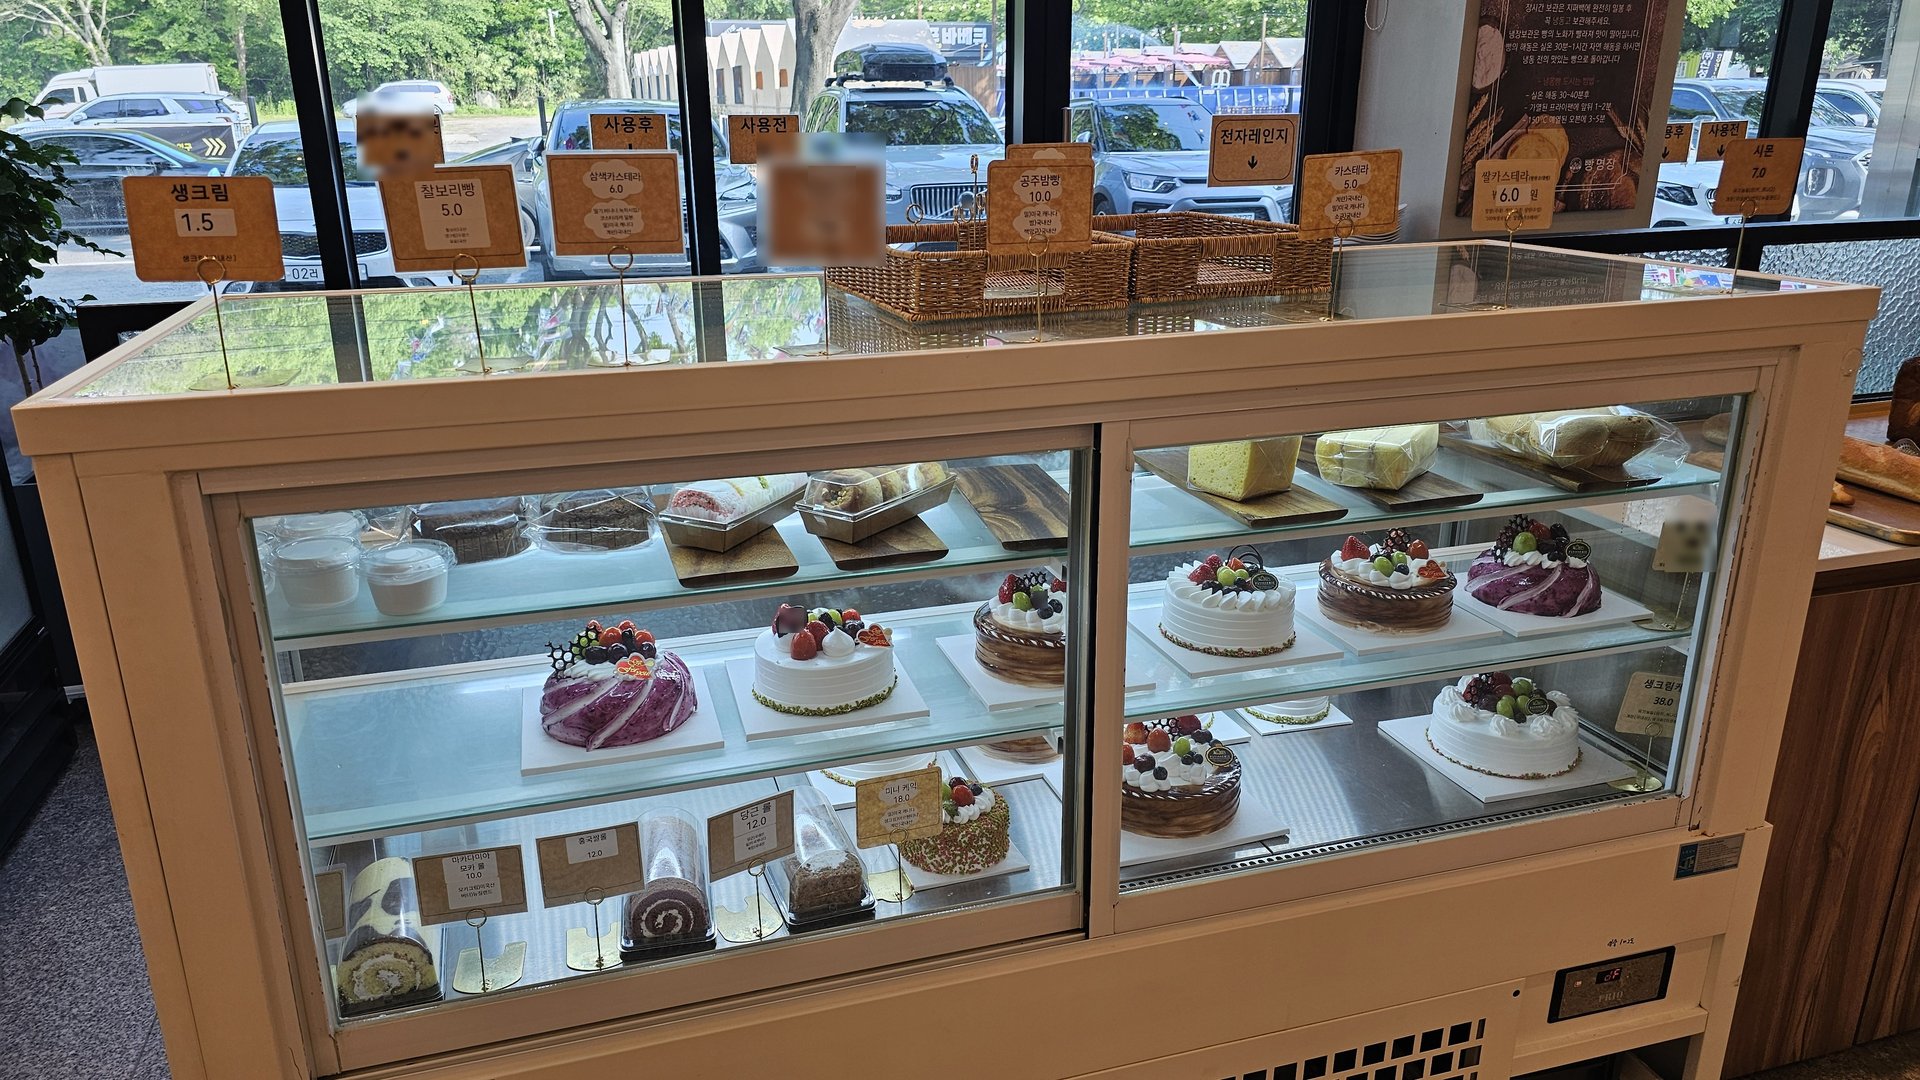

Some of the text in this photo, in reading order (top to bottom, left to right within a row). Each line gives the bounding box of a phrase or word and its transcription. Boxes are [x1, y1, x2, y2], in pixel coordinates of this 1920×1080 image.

[1526, 3, 1544, 13] 장시간
[1546, 3, 1565, 13] 보관은
[1508, 29, 1540, 40] 냉장보관은
[1541, 29, 1554, 40] 빵의
[1522, 55, 1535, 65] 냉동
[1570, 54, 1590, 64] 빵으로
[1531, 90, 1544, 100] 실온
[604, 116, 654, 134] 사용후
[740, 116, 788, 134] 사용전
[1708, 124, 1740, 138] 사용전
[1220, 128, 1288, 145] 전자레인지
[1664, 126, 1684, 140] 용후
[1334, 164, 1369, 177] 카스테라
[1584, 158, 1616, 171] 빵명장
[590, 172, 641, 182] 삼색카스테라
[1482, 170, 1530, 184] 쌀카스테라
[1752, 168, 1766, 178] 7.0
[1020, 174, 1060, 188] 공주밤빵
[1344, 180, 1358, 190] 5.0
[170, 184, 229, 202] 생크림
[420, 183, 476, 198] 찰보리빵
[609, 184, 624, 194] 6.0
[1500, 187, 1520, 202] 6.0
[1530, 188, 1538, 201] 원
[1029, 190, 1051, 202] 10.0
[441, 203, 463, 217] 5.0
[181, 213, 214, 232] 1.5
[1653, 696, 1674, 706] 38.0
[885, 784, 900, 794] 미니
[894, 793, 910, 804] 18.0
[740, 806, 760, 821] 당근
[746, 816, 767, 830] 12.0
[451, 852, 490, 864] 마카다미아
[587, 850, 603, 858] 12.0
[460, 864, 475, 872] 모카
[466, 871, 482, 880] 10.0
